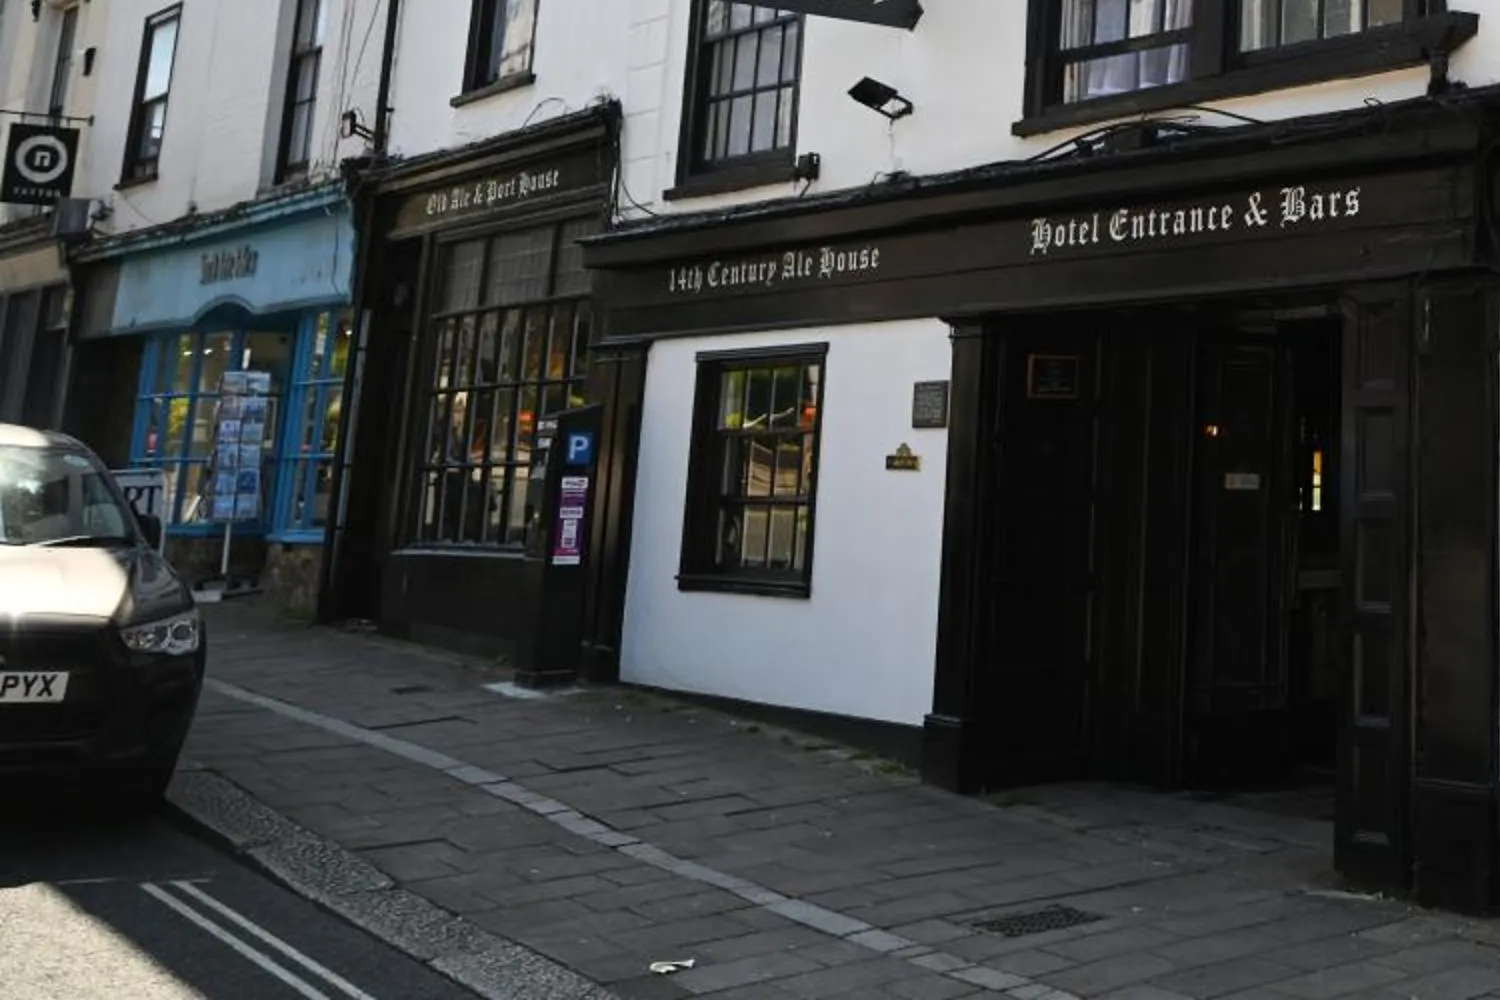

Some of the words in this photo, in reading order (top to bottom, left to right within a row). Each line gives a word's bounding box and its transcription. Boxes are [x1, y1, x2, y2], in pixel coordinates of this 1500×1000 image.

[426, 192, 447, 215] Old
[451, 187, 471, 210] Ale
[473, 183, 484, 205] &
[487, 180, 517, 208] Port
[519, 169, 560, 199] House
[1030, 213, 1100, 255] Hotel
[1109, 205, 1234, 242] Entrance
[1244, 191, 1268, 227] &
[1280, 186, 1362, 227] Bars
[668, 266, 703, 294] 14th
[707, 261, 777, 288] Century
[782, 251, 813, 280] Ale
[818, 246, 881, 279] House
[569, 434, 589, 460] P
